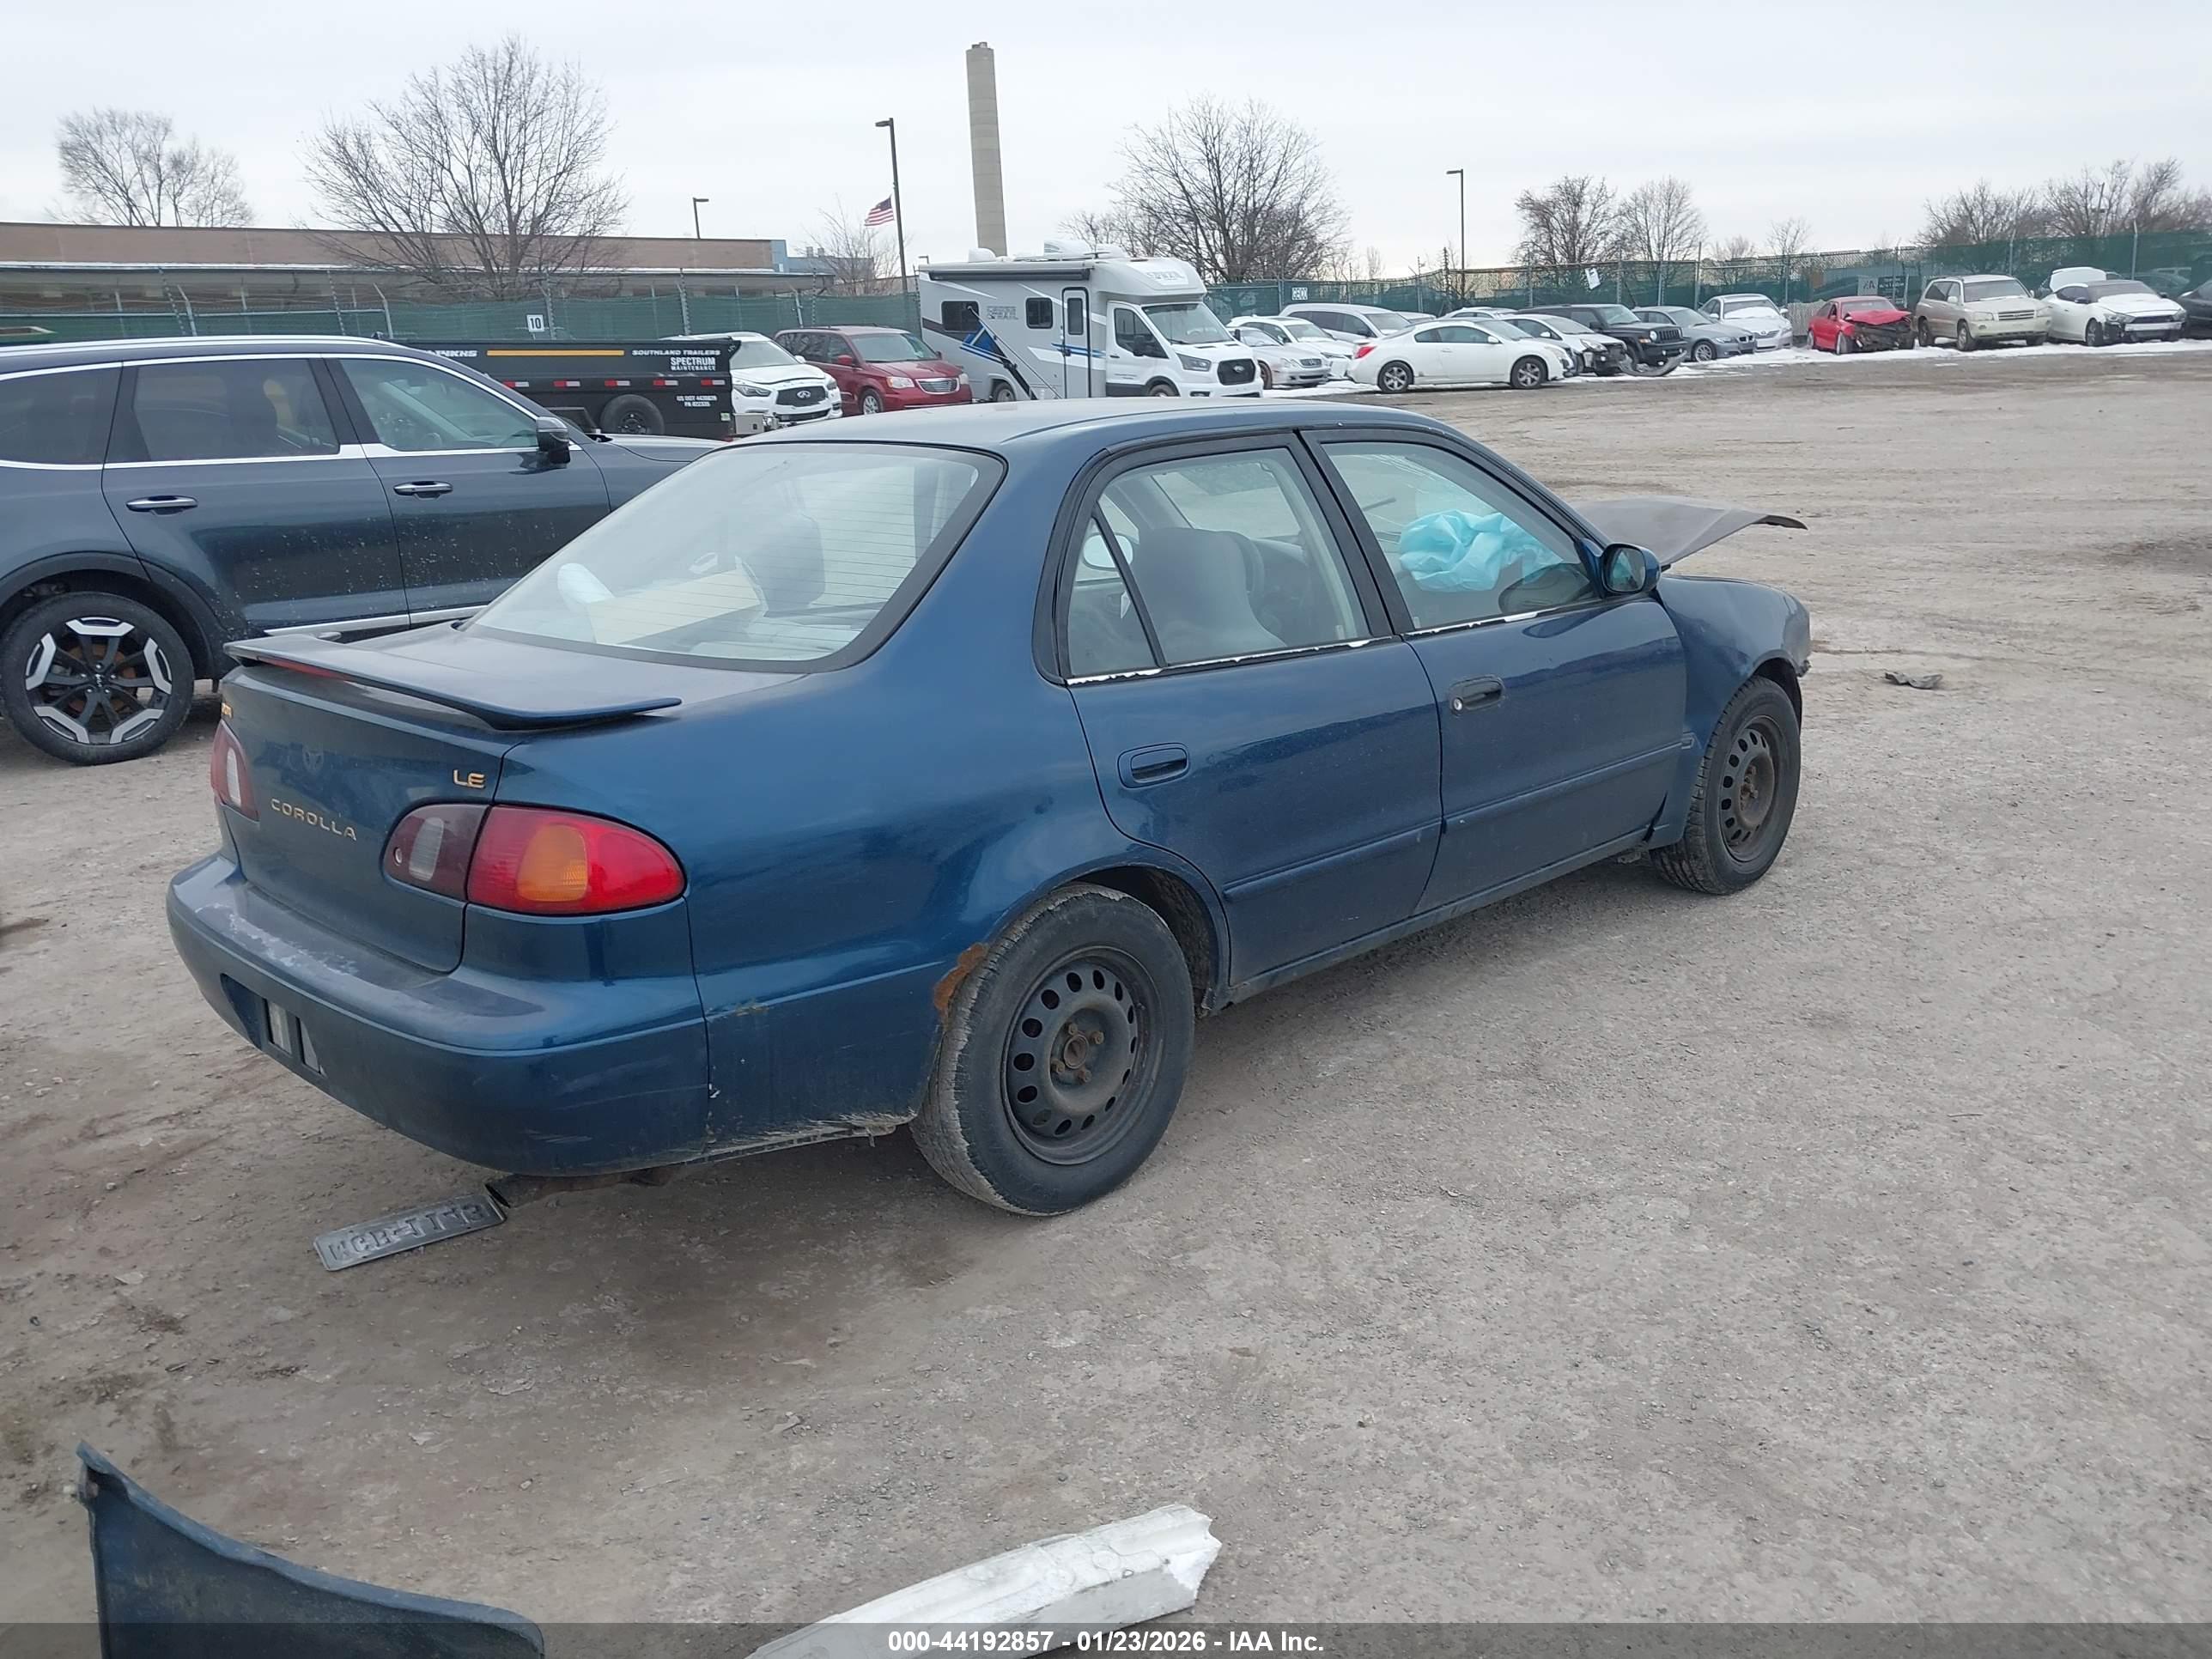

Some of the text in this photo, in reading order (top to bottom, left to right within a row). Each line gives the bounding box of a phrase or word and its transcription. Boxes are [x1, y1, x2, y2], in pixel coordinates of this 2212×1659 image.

[530, 317, 542, 329] 10
[670, 356, 715, 366] SPECTRUM
[453, 769, 485, 789] LE
[270, 798, 357, 842] COROLLA
